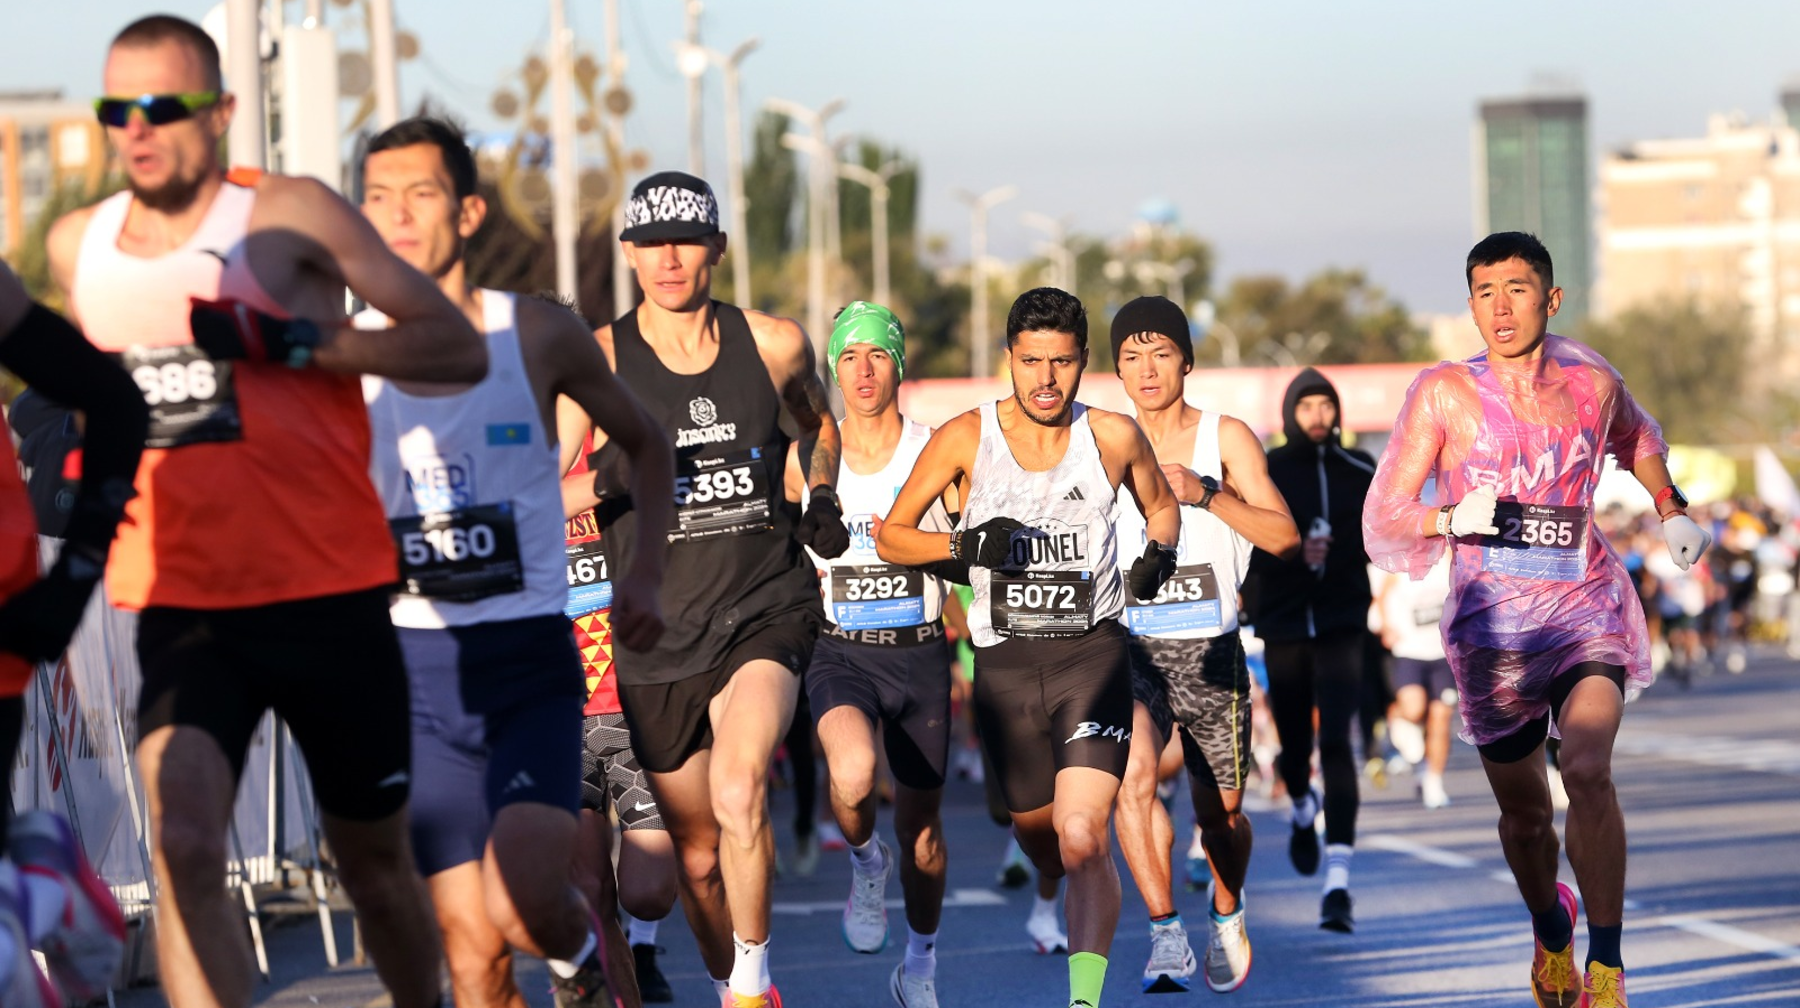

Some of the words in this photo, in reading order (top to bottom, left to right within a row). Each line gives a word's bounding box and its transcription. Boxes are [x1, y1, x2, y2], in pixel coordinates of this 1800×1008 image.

[674, 467, 754, 505] 5393
[848, 521, 875, 538] ME
[855, 532, 876, 550] 36
[1503, 518, 1573, 546] 2365
[402, 524, 496, 566] 5160
[1003, 532, 1085, 566] OUNEL
[846, 575, 909, 601] 3292
[1006, 584, 1076, 609] 5072
[1136, 577, 1203, 605] 343
[837, 605, 847, 619] F
[1131, 609, 1140, 623] F
